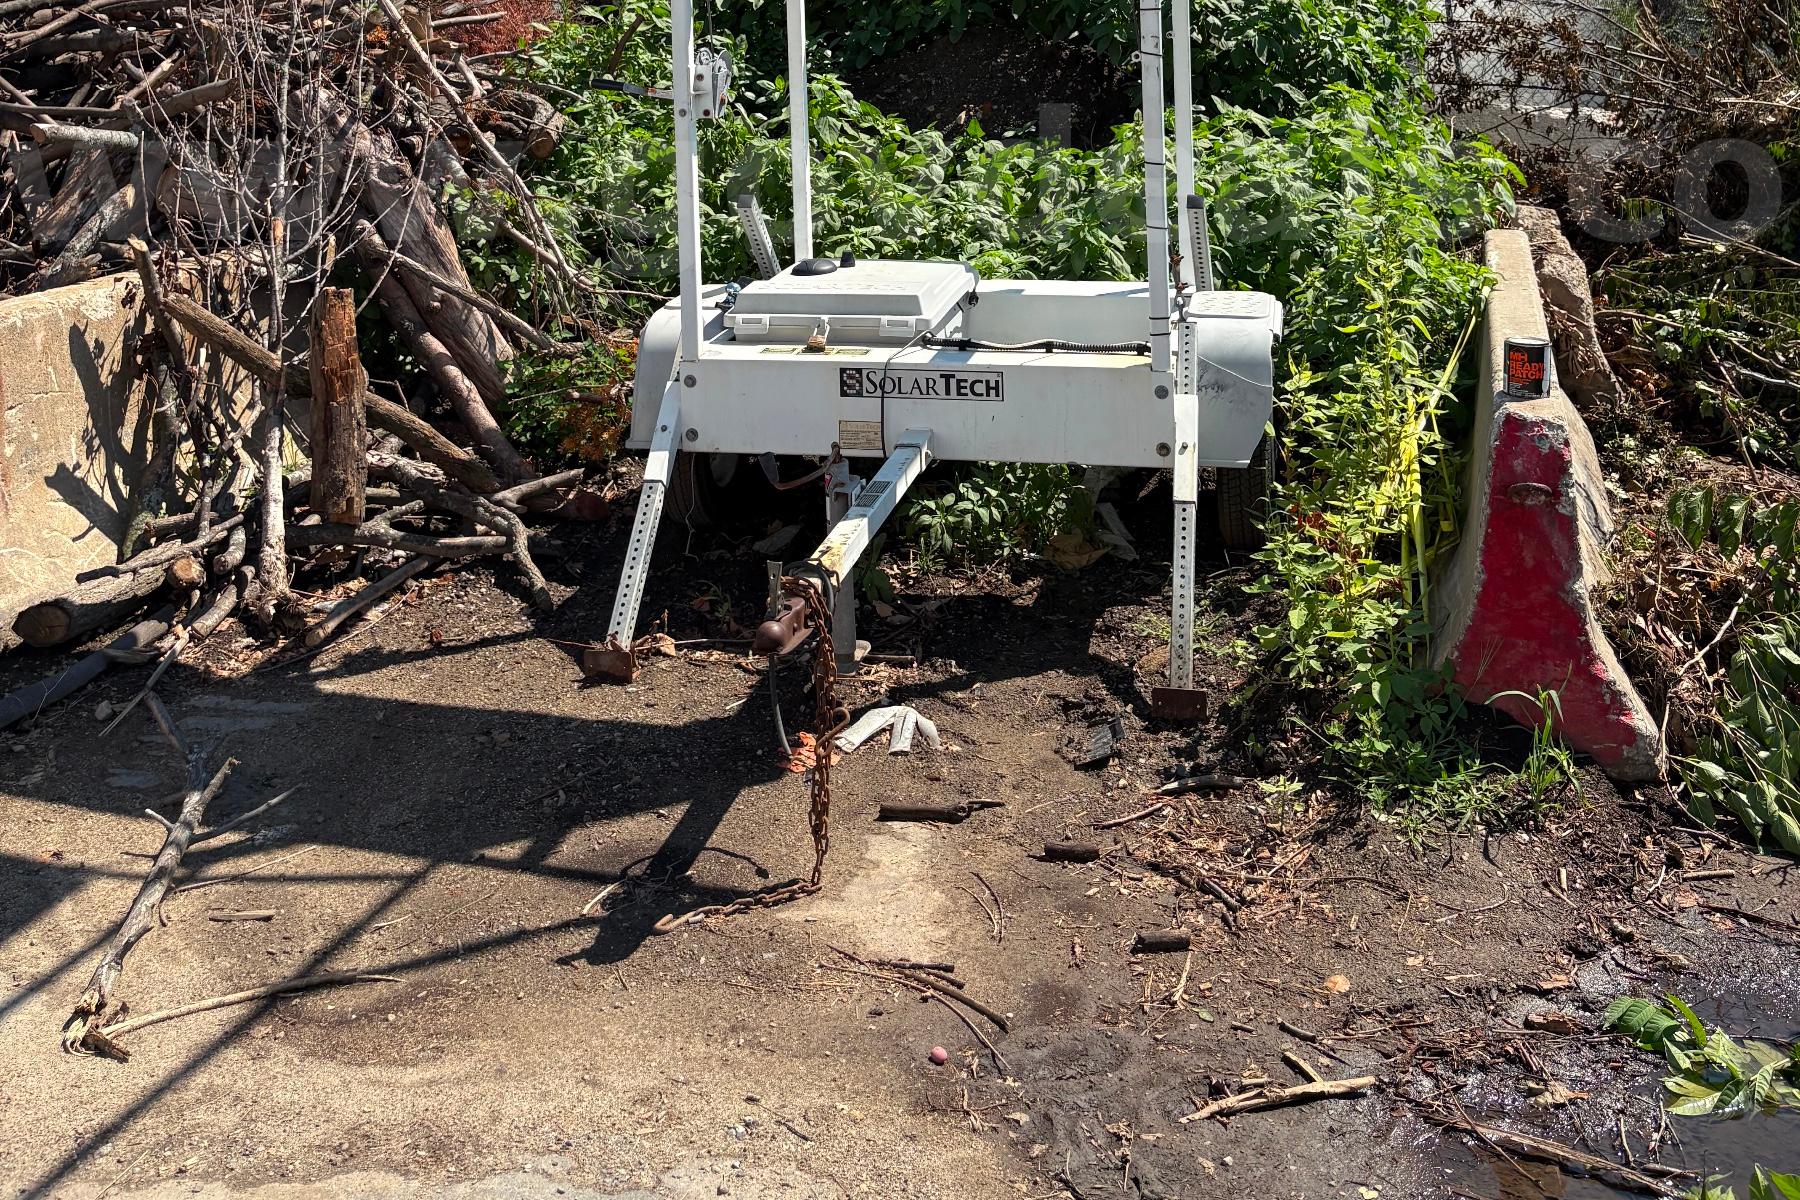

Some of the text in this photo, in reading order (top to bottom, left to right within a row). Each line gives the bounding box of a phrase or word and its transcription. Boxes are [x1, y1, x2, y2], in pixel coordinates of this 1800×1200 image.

[1509, 360, 1544, 371] READY
[1509, 368, 1543, 380] PATCH
[865, 370, 1000, 398] SOLARTECH
